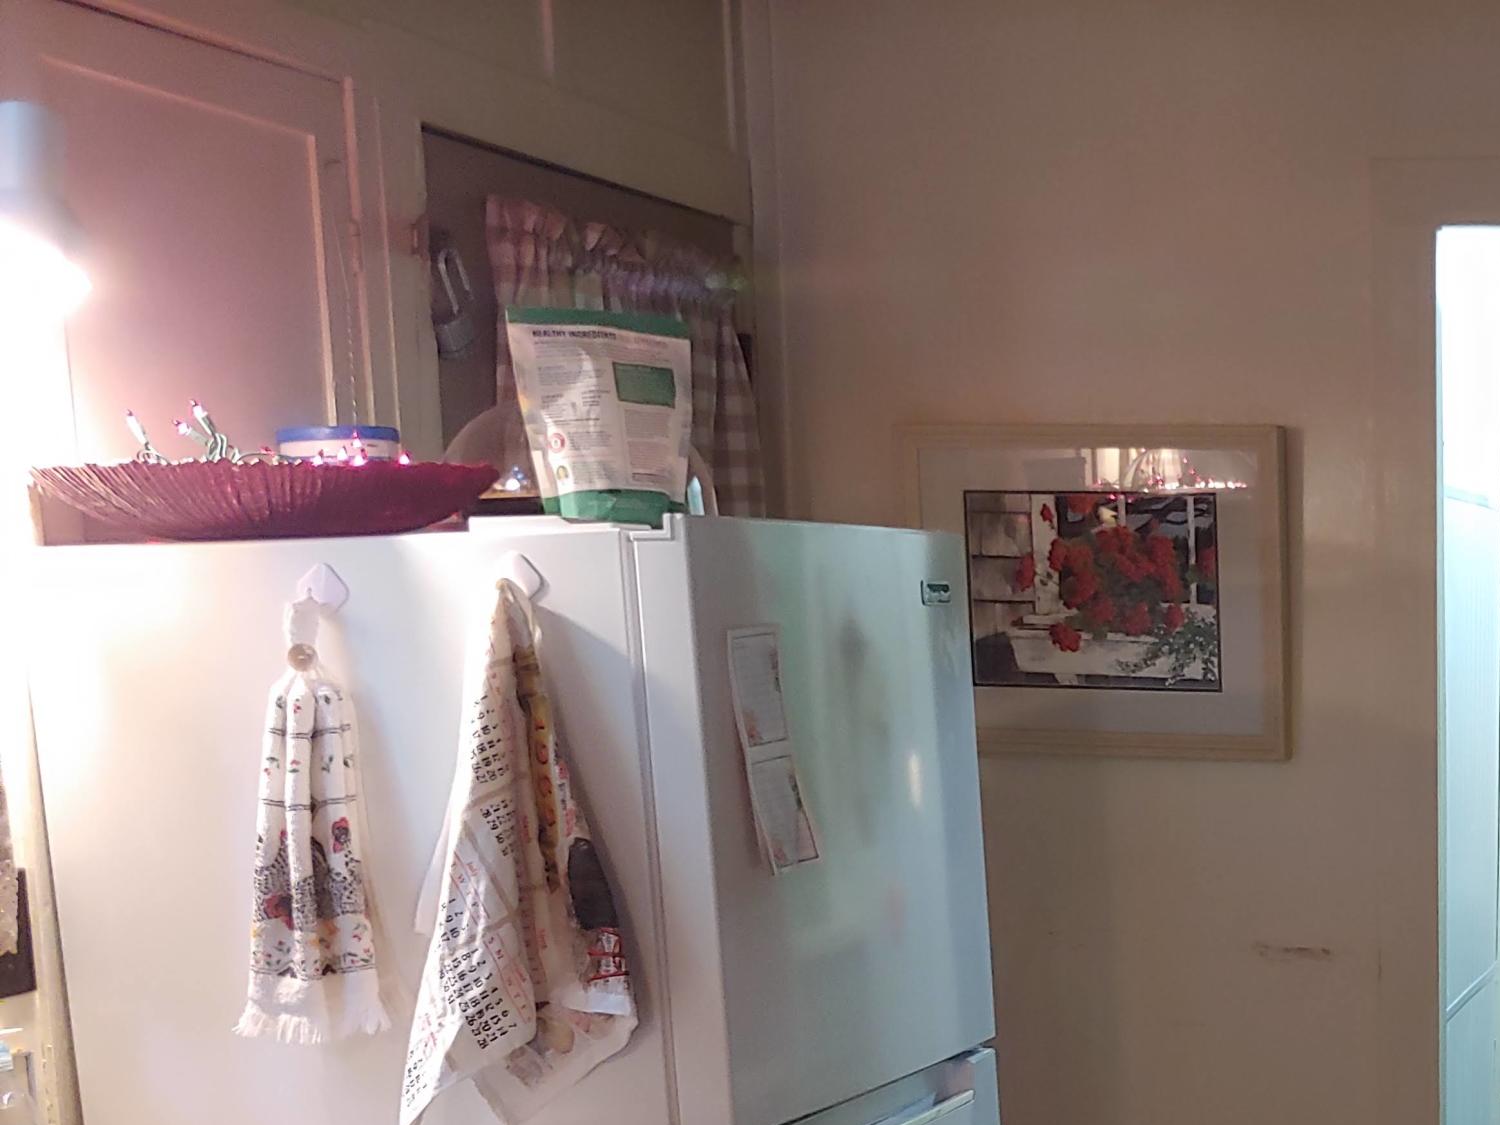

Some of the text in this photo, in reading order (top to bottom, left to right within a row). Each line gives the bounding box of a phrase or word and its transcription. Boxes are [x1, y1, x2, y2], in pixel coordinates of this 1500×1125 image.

[569, 331, 617, 340] INGREDIENTS
[481, 724, 491, 735] 10
[440, 931, 450, 942] 17
[450, 927, 460, 938] 10
[461, 952, 471, 961] 8
[468, 965, 477, 973] 9
[473, 977, 483, 988] 10
[480, 990, 490, 1000] 11
[451, 957, 462, 968] 15
[457, 970, 467, 981] 16
[462, 983, 474, 993] 17
[469, 995, 481, 1007] 18
[465, 1015, 476, 1026] 26
